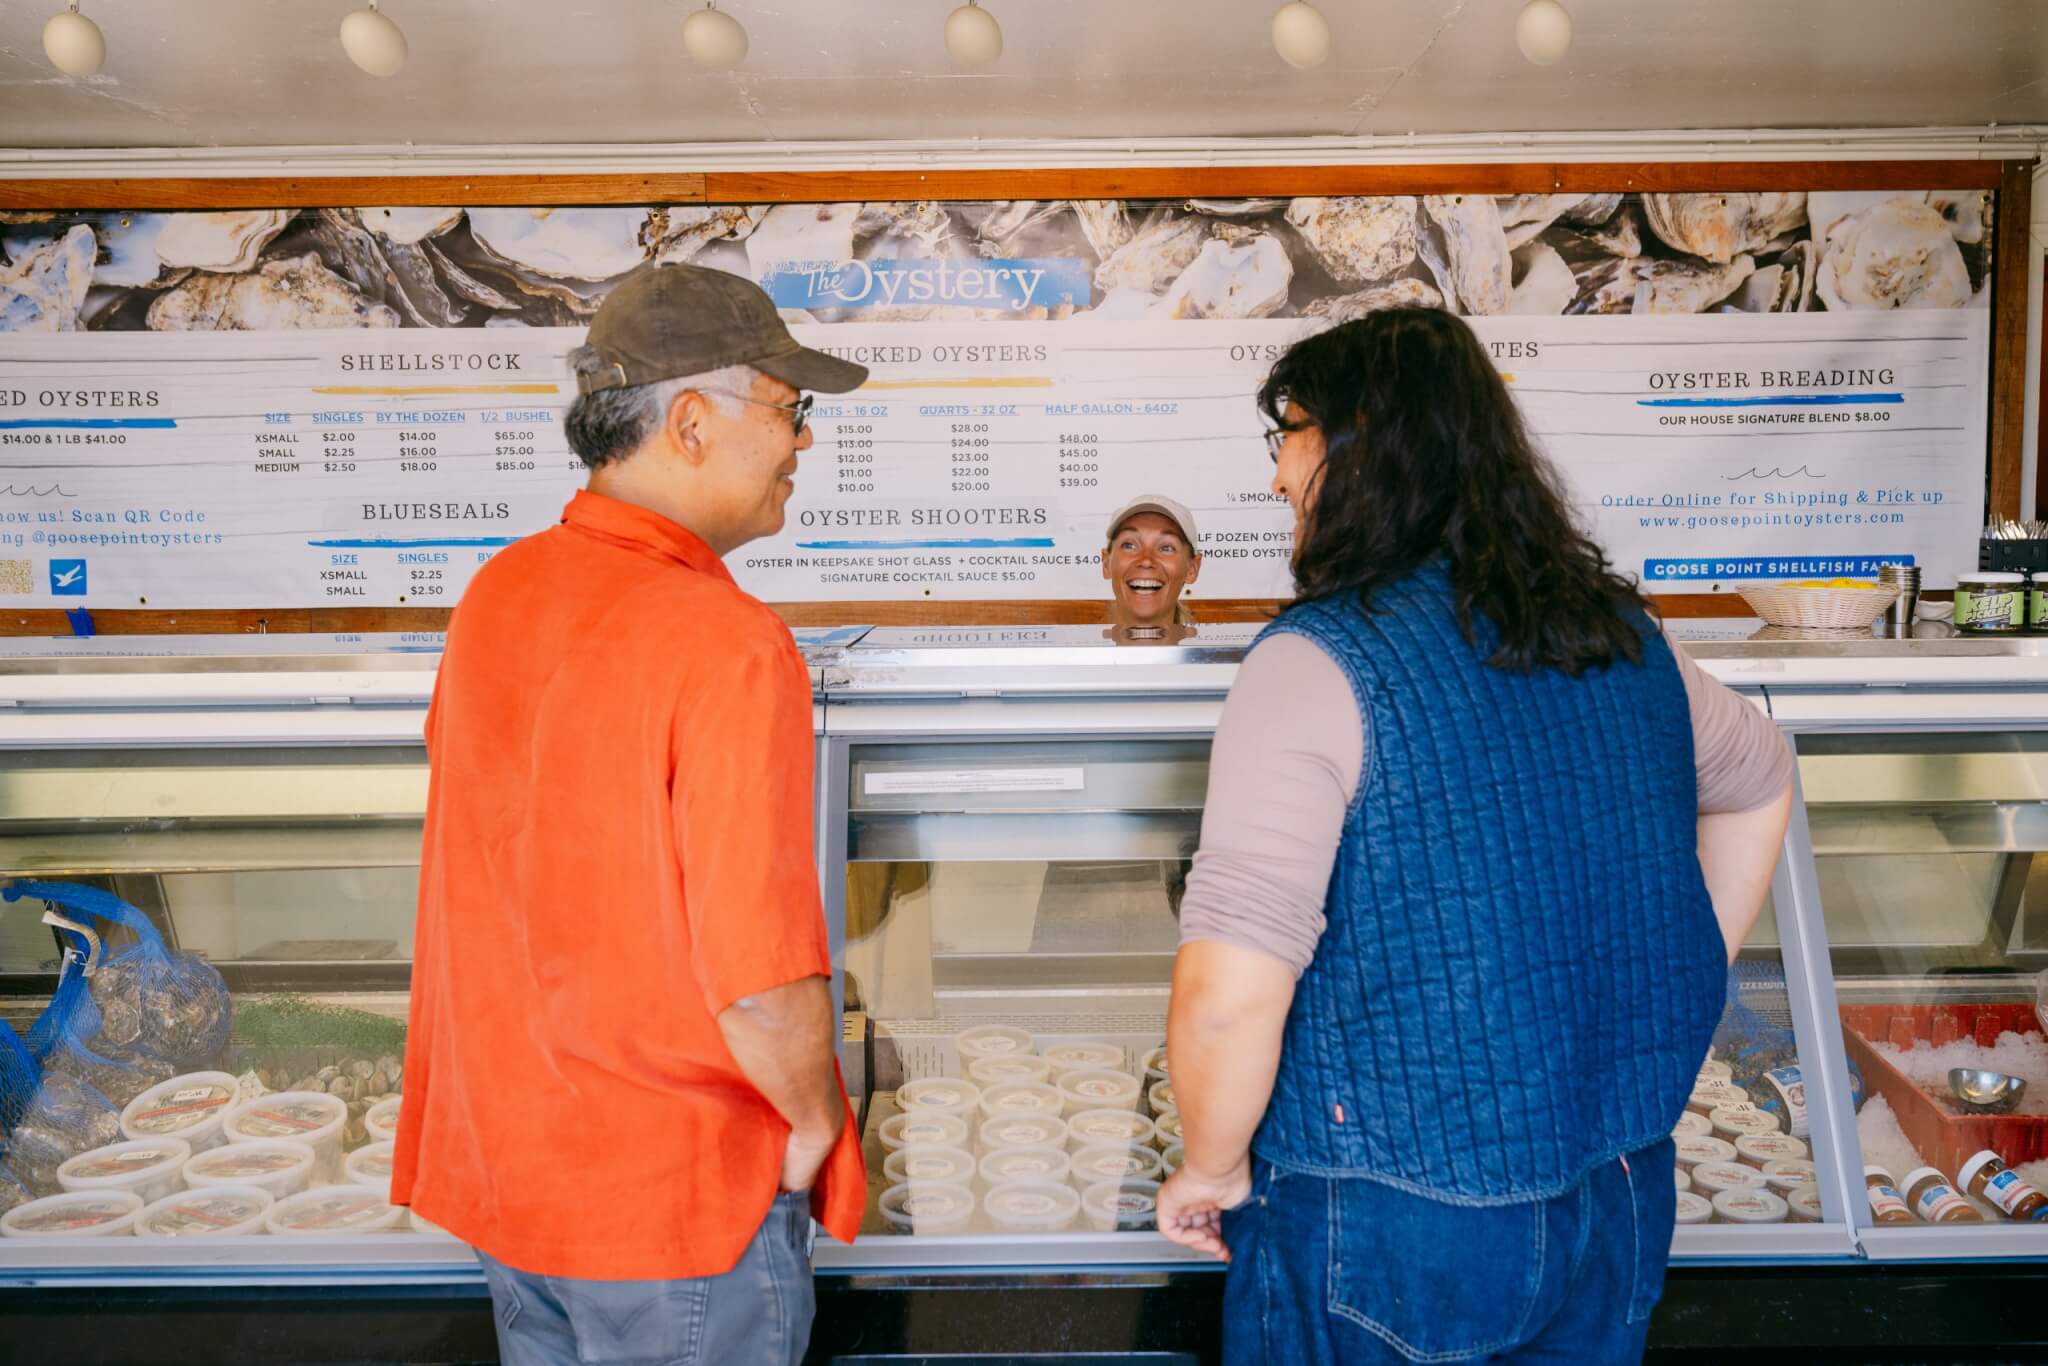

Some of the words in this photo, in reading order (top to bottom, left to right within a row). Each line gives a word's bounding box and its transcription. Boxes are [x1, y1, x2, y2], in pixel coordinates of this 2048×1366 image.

[807, 268, 841, 298] The
[835, 259, 1046, 312] Oystery
[933, 345, 1046, 362] OYSTERS
[342, 354, 520, 371] SHELLSTOCK
[1650, 373, 1750, 389] OYSTER
[1760, 369, 1894, 387] BREADING
[39, 391, 158, 407] OYSTERS
[855, 406, 868, 416] 16
[871, 406, 888, 416] OZ
[919, 405, 969, 416] QUARTS
[982, 405, 996, 415] 32
[999, 405, 1016, 415] OZ
[1045, 404, 1078, 414] HALF
[1081, 404, 1132, 414] GALLON
[1144, 403, 1178, 413] 64OZ
[265, 413, 290, 422] SIZE
[312, 412, 364, 423] SINGLES
[376, 412, 392, 422] BY
[395, 412, 418, 422] THE
[423, 412, 465, 422] DOZEN
[480, 412, 500, 422] 1/2
[506, 411, 553, 421] BUSHEL
[1660, 416, 1686, 425] OUR
[1691, 415, 1733, 424] HOUSE
[1738, 414, 1805, 423] SIGNATURE
[1809, 413, 1850, 422] BLEND
[1855, 412, 1890, 422] $8.00
[837, 425, 872, 434] $15.00
[952, 424, 988, 433] $28.00
[3, 435, 40, 444] $14.00
[45, 435, 52, 444] &
[65, 435, 80, 444] LB
[85, 435, 126, 444] $41.00
[256, 434, 299, 443] XSMALL
[323, 433, 355, 442] $2.00
[399, 432, 436, 441] $14.00
[495, 432, 534, 440] $65.00
[837, 439, 873, 449] $13.00
[951, 438, 989, 448] $24.00
[1059, 433, 1098, 444] $48.00
[259, 449, 295, 457] SMALL
[324, 448, 354, 457] $2.25
[400, 447, 436, 456] $16.00
[496, 447, 534, 455] $75.00
[838, 454, 872, 463] $12.00
[952, 453, 989, 462] $23.00
[1060, 449, 1098, 458] $45.00
[255, 463, 300, 472] MEDIUM
[325, 462, 355, 472] $2.50
[401, 462, 436, 472] $18.00
[496, 462, 535, 471] $85.00
[839, 469, 872, 478] $11.00
[952, 468, 989, 476] $22.00
[1059, 464, 1098, 472] $40.00
[838, 483, 874, 493] $10.00
[952, 482, 990, 491] $20.00
[1060, 478, 1097, 487] $39.00
[1601, 495, 1654, 507] Order
[1662, 493, 1721, 506] Online
[1731, 493, 1756, 504] for
[1764, 491, 1848, 507] Shipping
[1856, 490, 1868, 503] &
[1877, 490, 1914, 502] Pick
[1923, 492, 1942, 504] up
[0, 513, 29, 522] ow
[38, 509, 64, 522] us!
[72, 510, 116, 522] Scan
[125, 510, 151, 524] QR
[160, 510, 205, 522] Code
[362, 503, 509, 519] BLUESEALS
[801, 510, 901, 526] OYSTER
[912, 508, 1046, 525] SHOOTERS
[1640, 512, 1904, 529] www.goosepointoysters.com
[32, 530, 222, 547] @goosepointoysters
[1216, 533, 1258, 542] DOZEN
[331, 554, 358, 563] SIZE
[398, 552, 449, 561] SINGLES
[746, 559, 792, 568] OYSTER
[797, 558, 808, 567] IN
[812, 557, 873, 567] KEEPSAKE
[878, 557, 908, 566] SHOT
[913, 557, 951, 566] GLASS
[969, 556, 1028, 565] COCKTAIL
[1032, 555, 1071, 564] SAUCE
[320, 571, 367, 579] XSMALL
[411, 570, 442, 580] $2.25
[1654, 564, 1708, 575] GOOSE
[1716, 563, 1764, 574] POINT
[1768, 562, 1854, 573] SHELLFISH
[821, 573, 889, 582] SIGNATURE
[893, 572, 953, 582] COCKTAIL
[958, 572, 997, 581] SAUCE
[1002, 572, 1035, 581] $5.00
[326, 586, 366, 595] SMALL
[410, 586, 443, 595] $2.50
